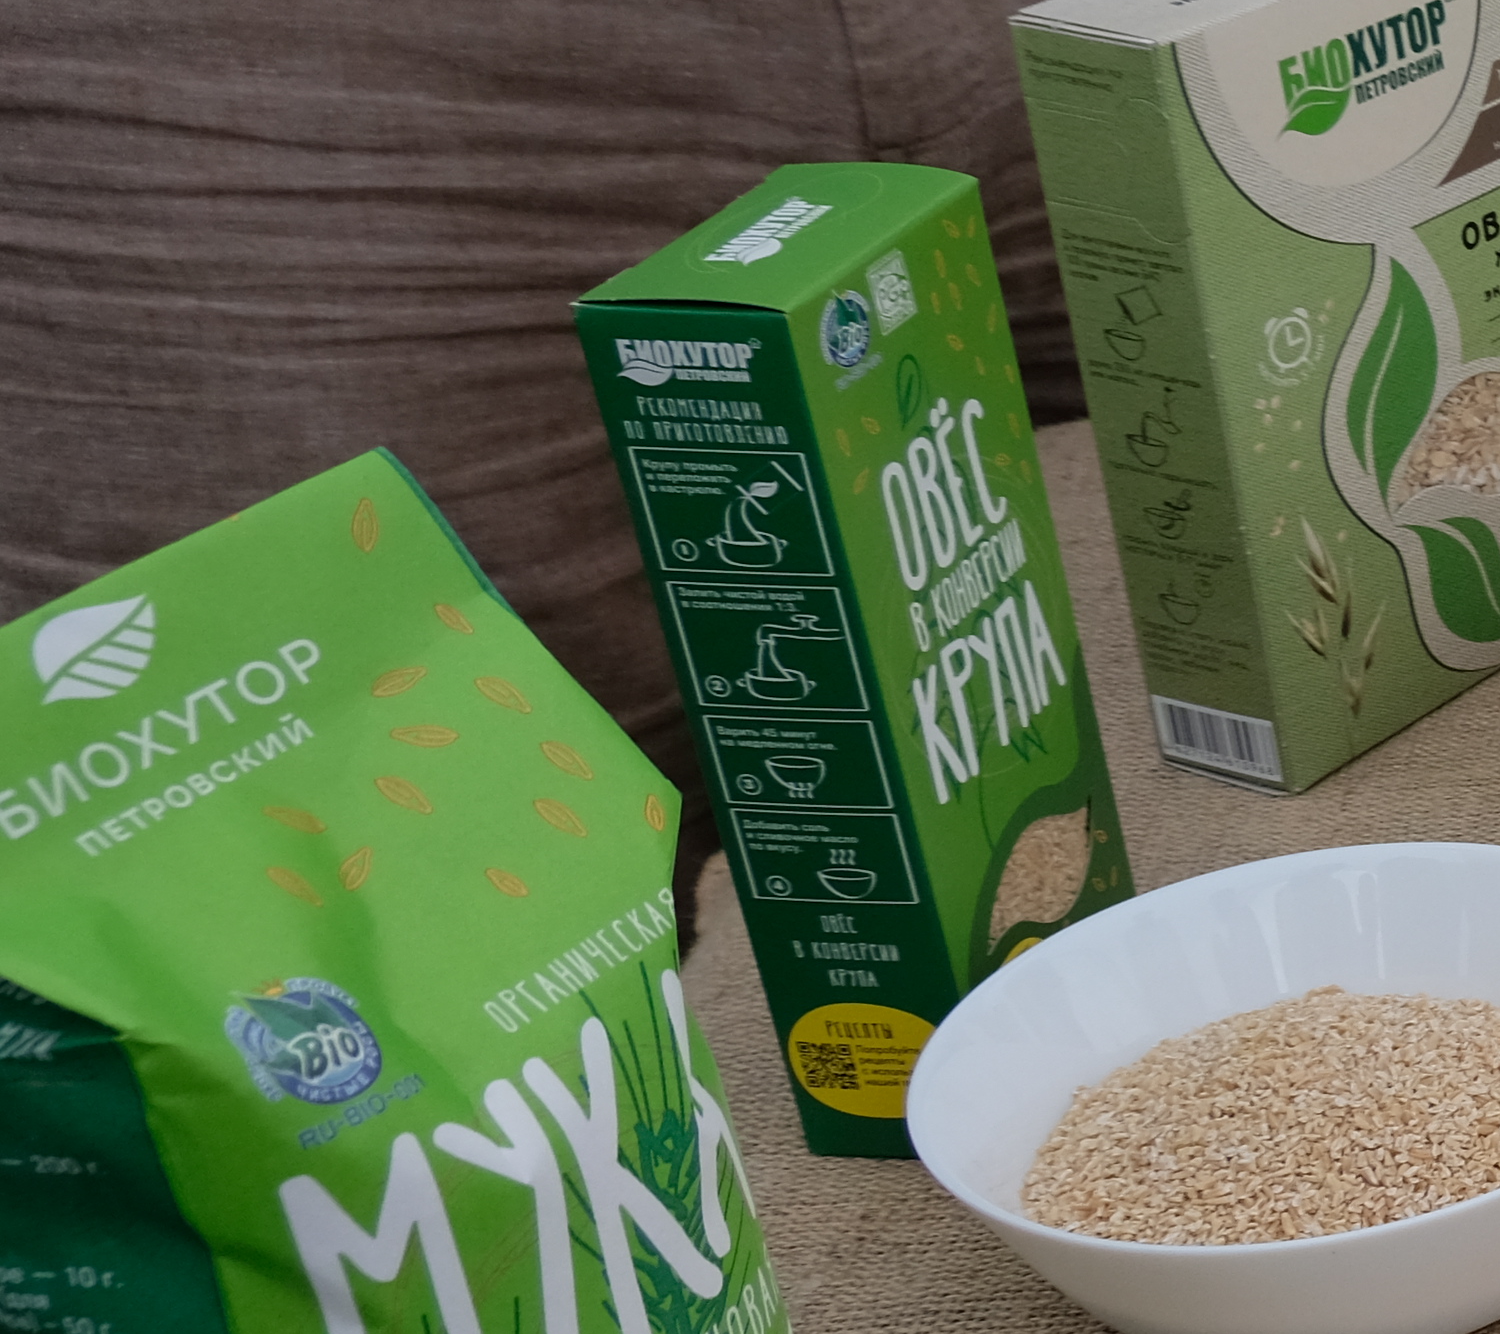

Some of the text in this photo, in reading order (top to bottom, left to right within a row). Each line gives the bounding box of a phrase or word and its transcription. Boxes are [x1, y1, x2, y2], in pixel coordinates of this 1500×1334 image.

[1354, 49, 1446, 104] ПЕТРОВСКИЙ
[614, 338, 753, 368] БИОХУТОР
[623, 419, 790, 445] ПО ПРИГОТОВЛЕНИЮ
[881, 397, 1007, 591] ОВЁС
[909, 518, 1027, 653] В КОНВЕРСИИ
[912, 579, 1067, 806] КРУПА
[0, 638, 322, 840] БИОХУТОР
[761, 728, 778, 738] 45
[75, 713, 316, 857] ПЕТРОВСКИЙ
[792, 940, 900, 961] В КОНВЕРСИИ
[820, 913, 858, 934] ОВЁС
[483, 887, 677, 1034] ОРГАНИЧЕСКАЯ
[828, 969, 880, 987] КРУПА
[286, 1023, 365, 1084] Bio
[825, 1020, 895, 1040] РЕЦЕПТЫ
[298, 1073, 425, 1150] RU-BIO-001
